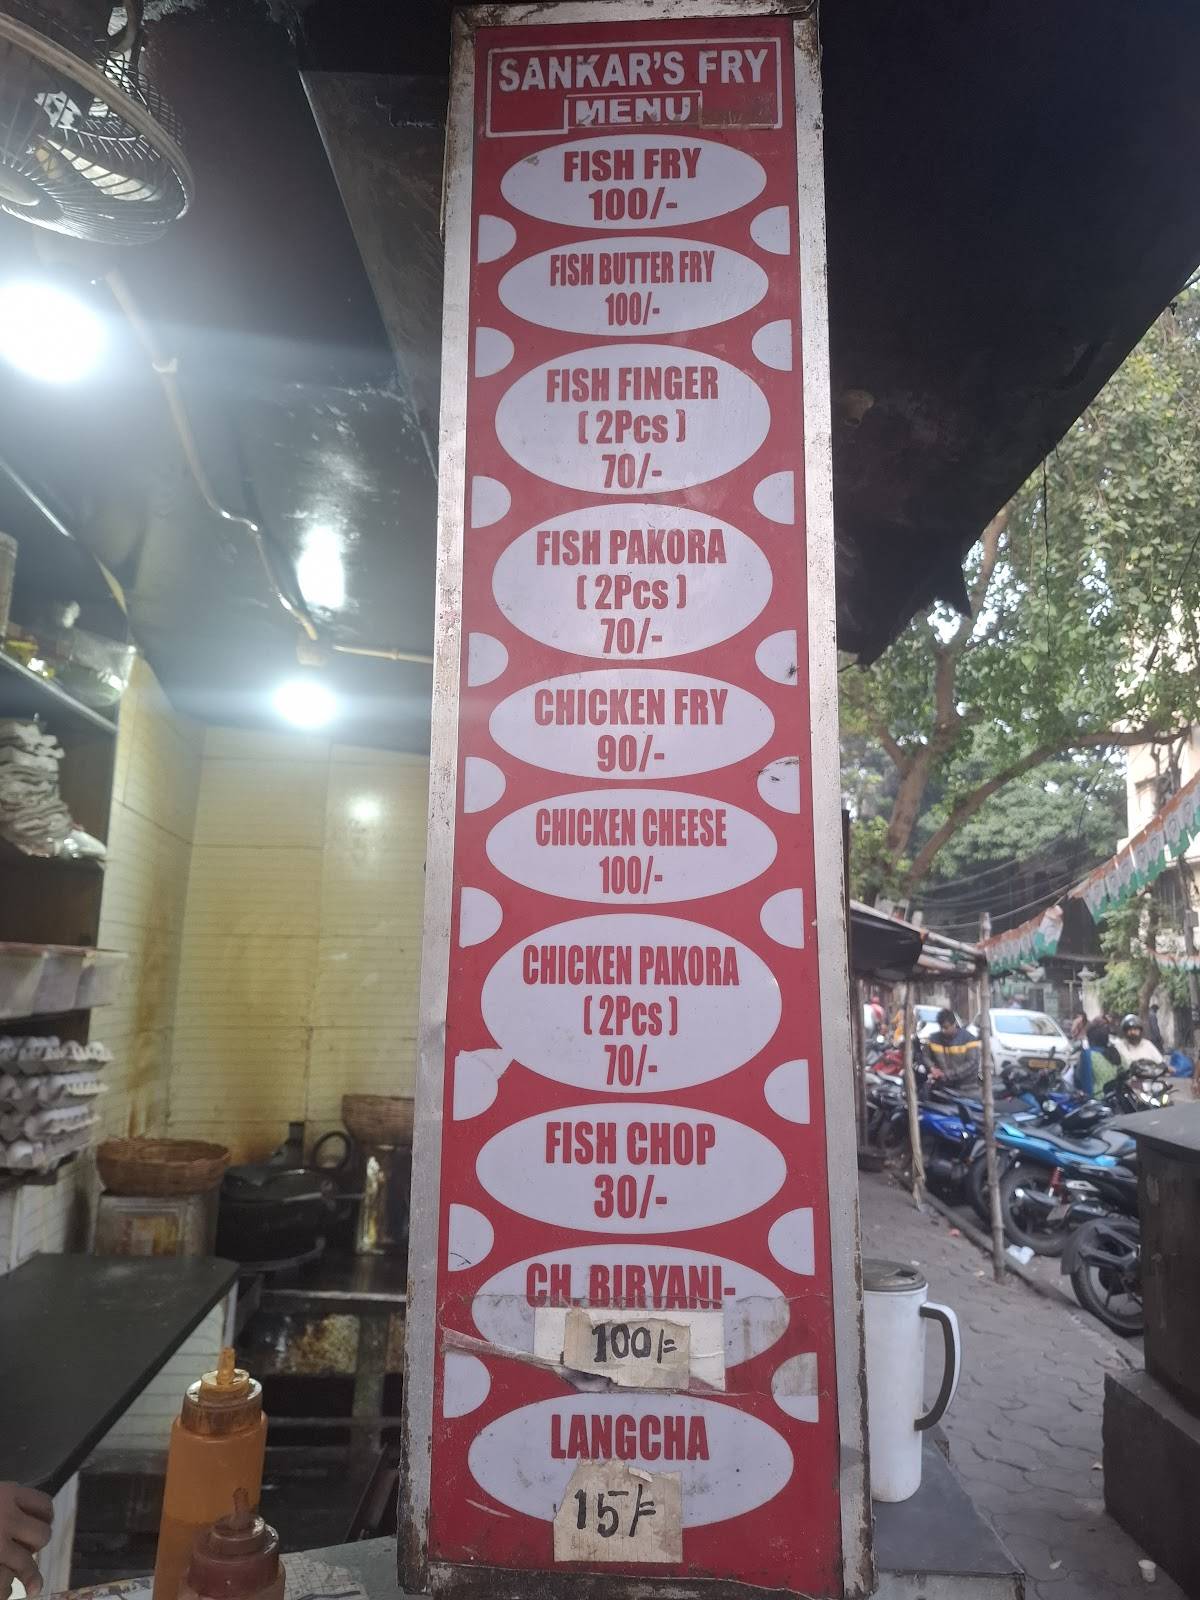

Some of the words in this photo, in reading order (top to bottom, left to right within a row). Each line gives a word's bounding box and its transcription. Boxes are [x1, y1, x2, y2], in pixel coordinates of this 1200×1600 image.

[499, 50, 685, 93] SANKAR'S
[699, 48, 769, 85] FRY
[574, 96, 691, 125] MENU
[563, 151, 635, 182] FISH
[643, 148, 701, 180] FRY
[588, 187, 678, 221] 100/-
[550, 253, 594, 286] FISH
[599, 251, 674, 285] BUTTER
[679, 250, 715, 283] FRY
[605, 292, 660, 326] 100/-
[546, 368, 610, 402] FISH
[618, 366, 719, 401] FINGER
[601, 453, 663, 489] 70/-
[536, 530, 601, 566] FISH
[609, 529, 727, 564] PAKORA
[600, 618, 663, 654] 70/-
[534, 689, 666, 726] CHICKEN
[674, 689, 729, 725] FRY
[597, 734, 665, 772] 90/-
[535, 808, 636, 847] CHICKEN
[642, 808, 727, 847] CHEESE
[599, 856, 664, 894] 100/-
[522, 945, 632, 985] CHICKEN
[639, 946, 740, 986] PAKORA
[604, 1044, 657, 1086] 70/-
[545, 1122, 617, 1164] FISH
[626, 1122, 716, 1166] CHOP
[593, 1174, 667, 1219] 30/-
[550, 1414, 710, 1461] LANGCHA
